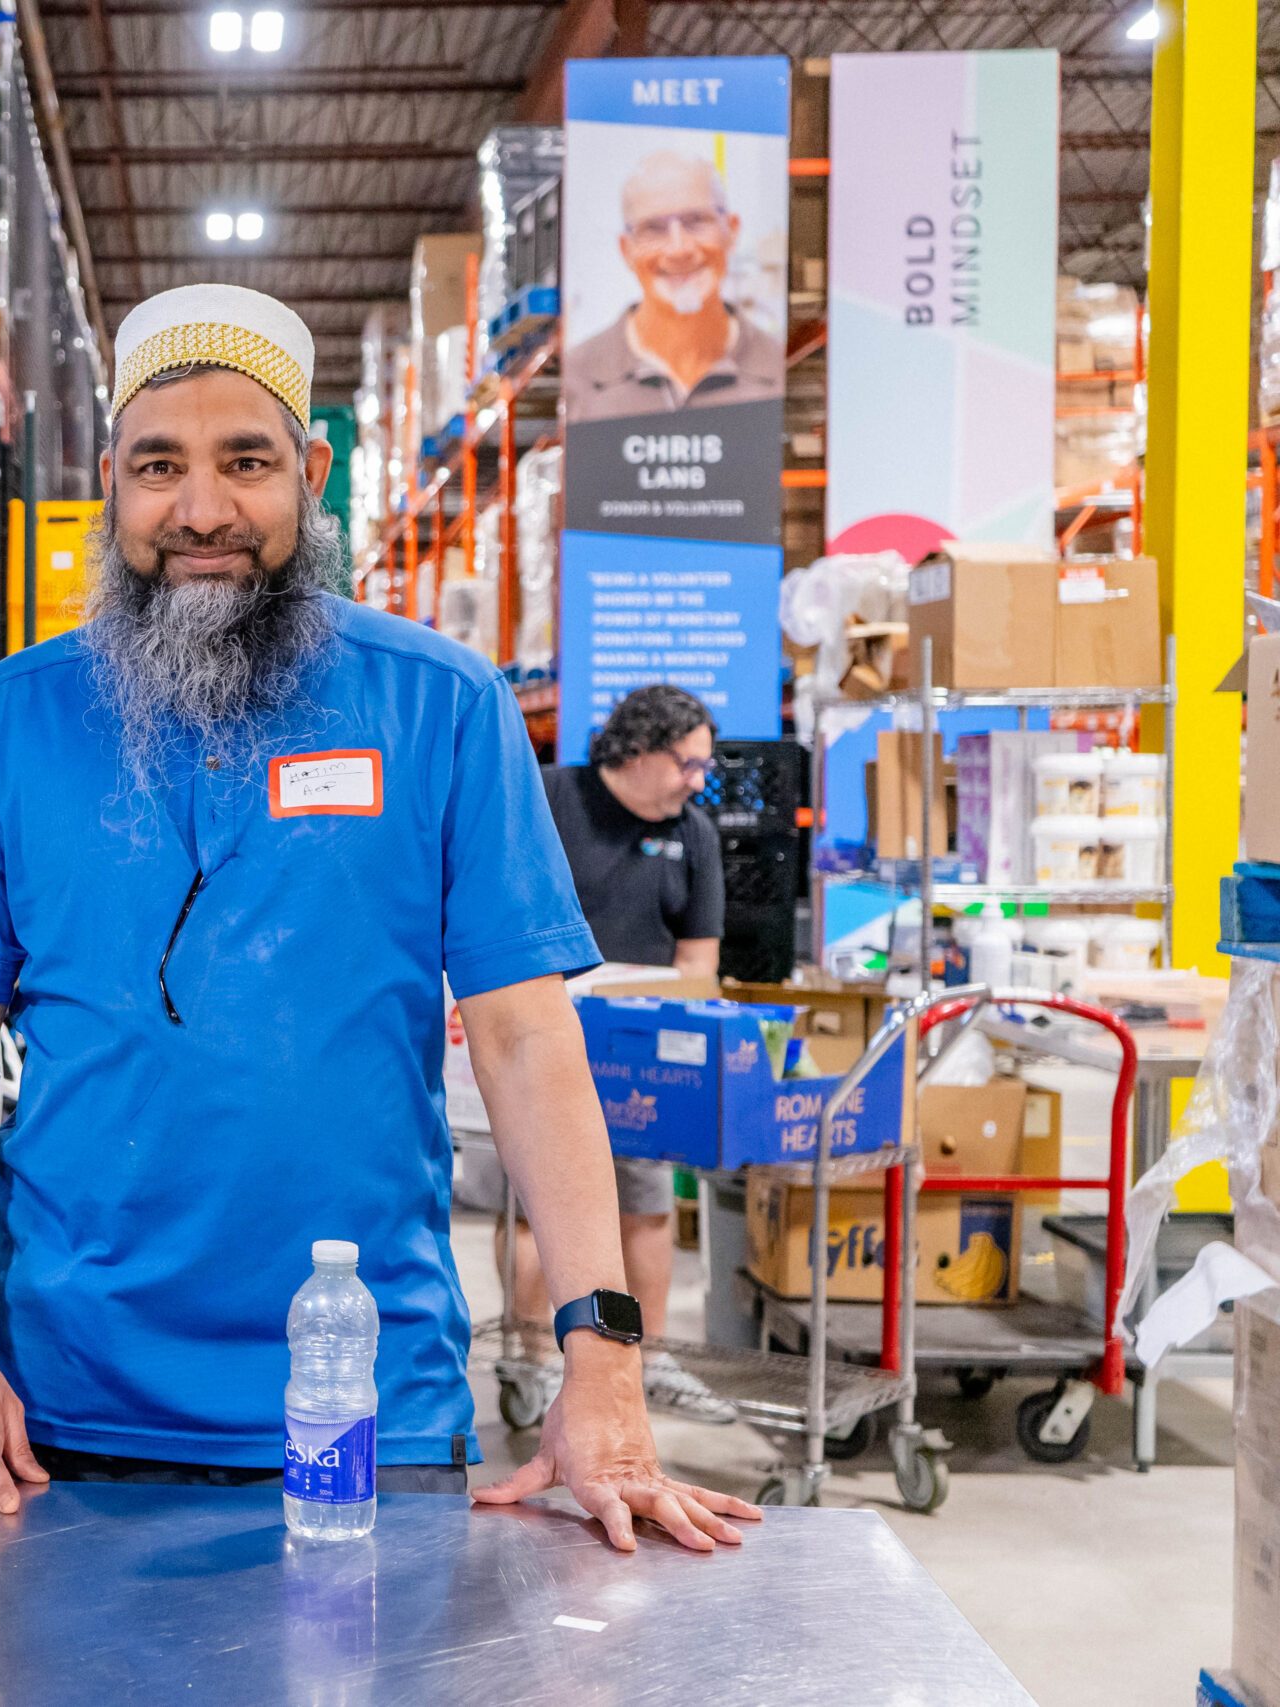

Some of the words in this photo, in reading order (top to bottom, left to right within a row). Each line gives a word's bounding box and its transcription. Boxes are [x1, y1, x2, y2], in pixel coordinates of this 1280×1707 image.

[633, 78, 723, 105] MEET
[951, 129, 982, 328] MINDSET
[905, 215, 935, 327] BOLD
[623, 435, 723, 464] CHRIS
[639, 467, 706, 489] LANG
[664, 500, 744, 516] VOLUNTEER
[651, 571, 731, 587] VOLUNTEER
[775, 1087, 865, 1122] ROMNE
[286, 1439, 340, 1468] eska
